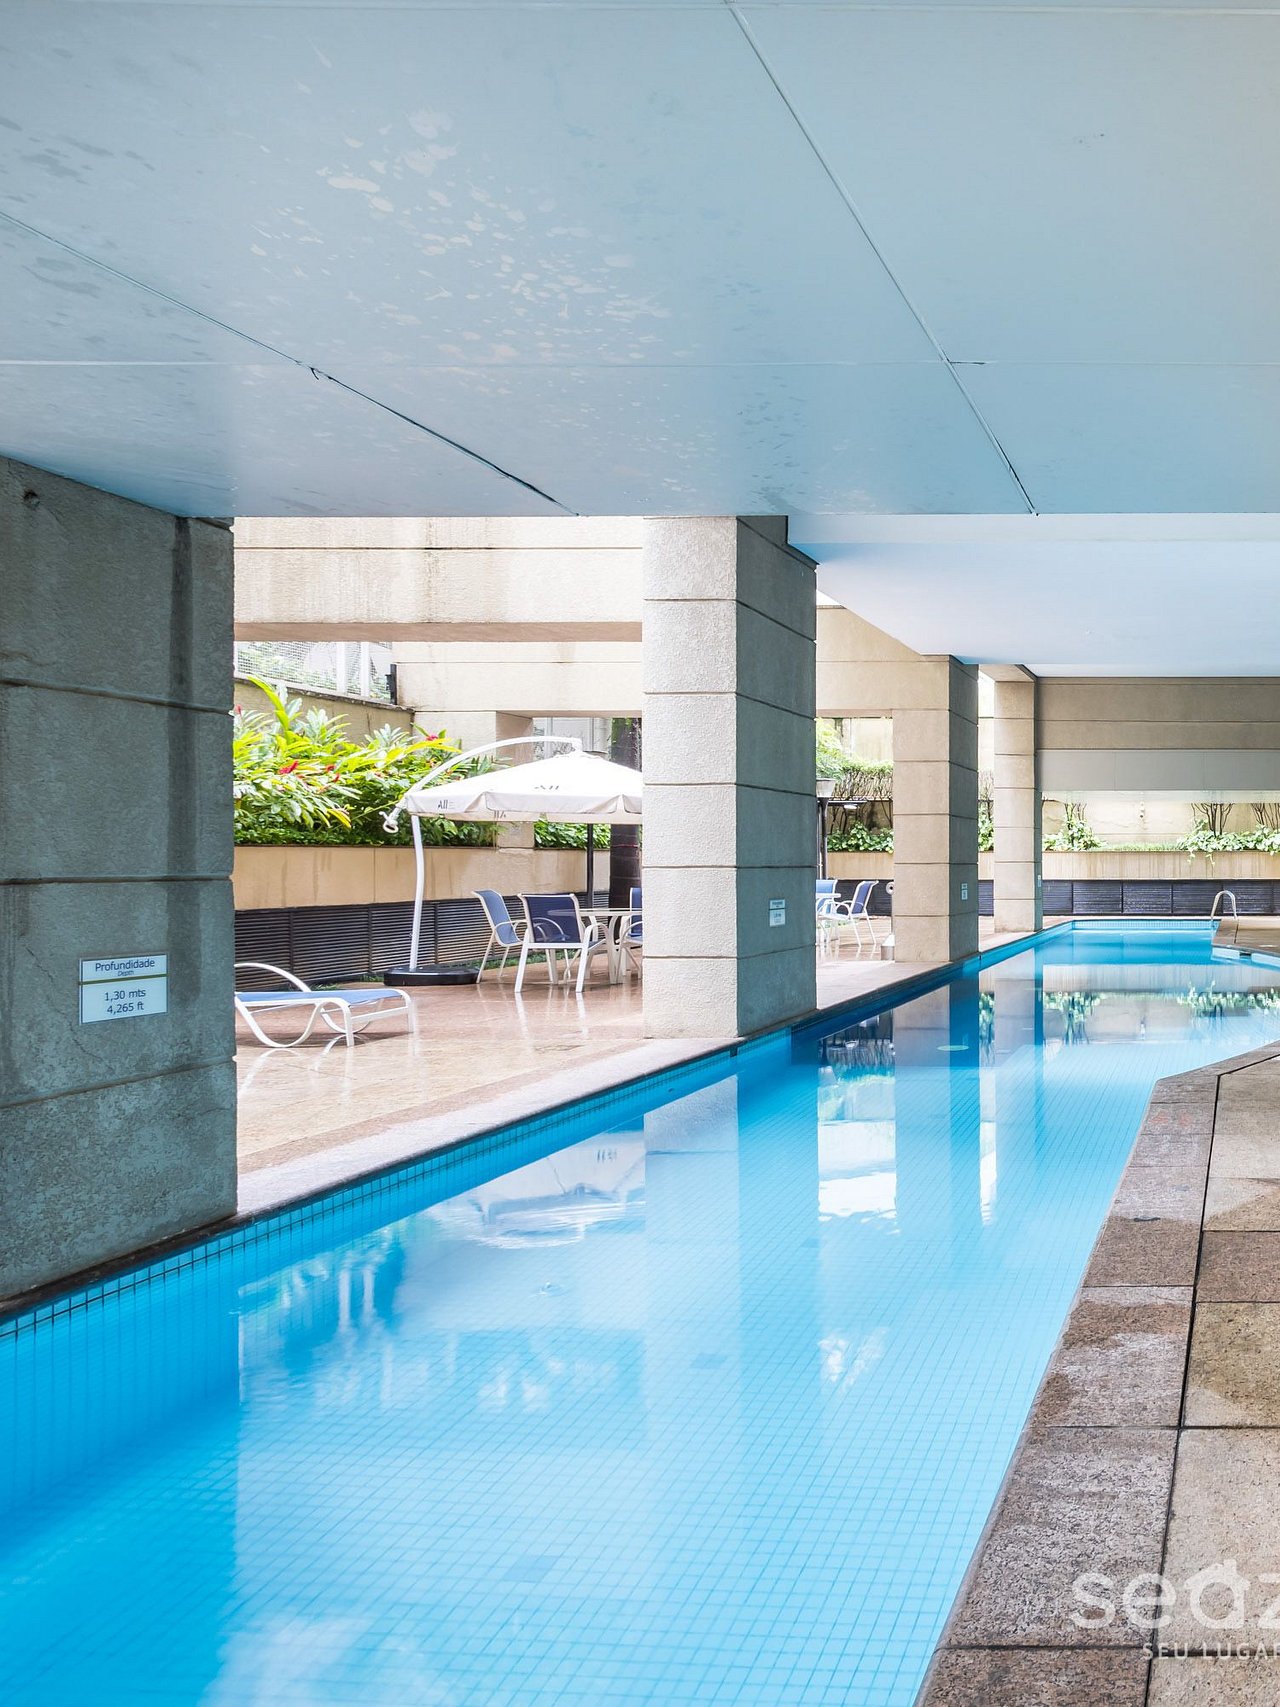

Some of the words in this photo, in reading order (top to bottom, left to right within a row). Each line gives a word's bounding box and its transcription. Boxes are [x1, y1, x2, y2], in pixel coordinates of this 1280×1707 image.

[95, 959, 155, 971] Profundidade
[104, 990, 125, 1002] 1,30
[129, 989, 146, 999] mts
[107, 1002, 134, 1014] 4,265
[137, 1002, 144, 1010] ft
